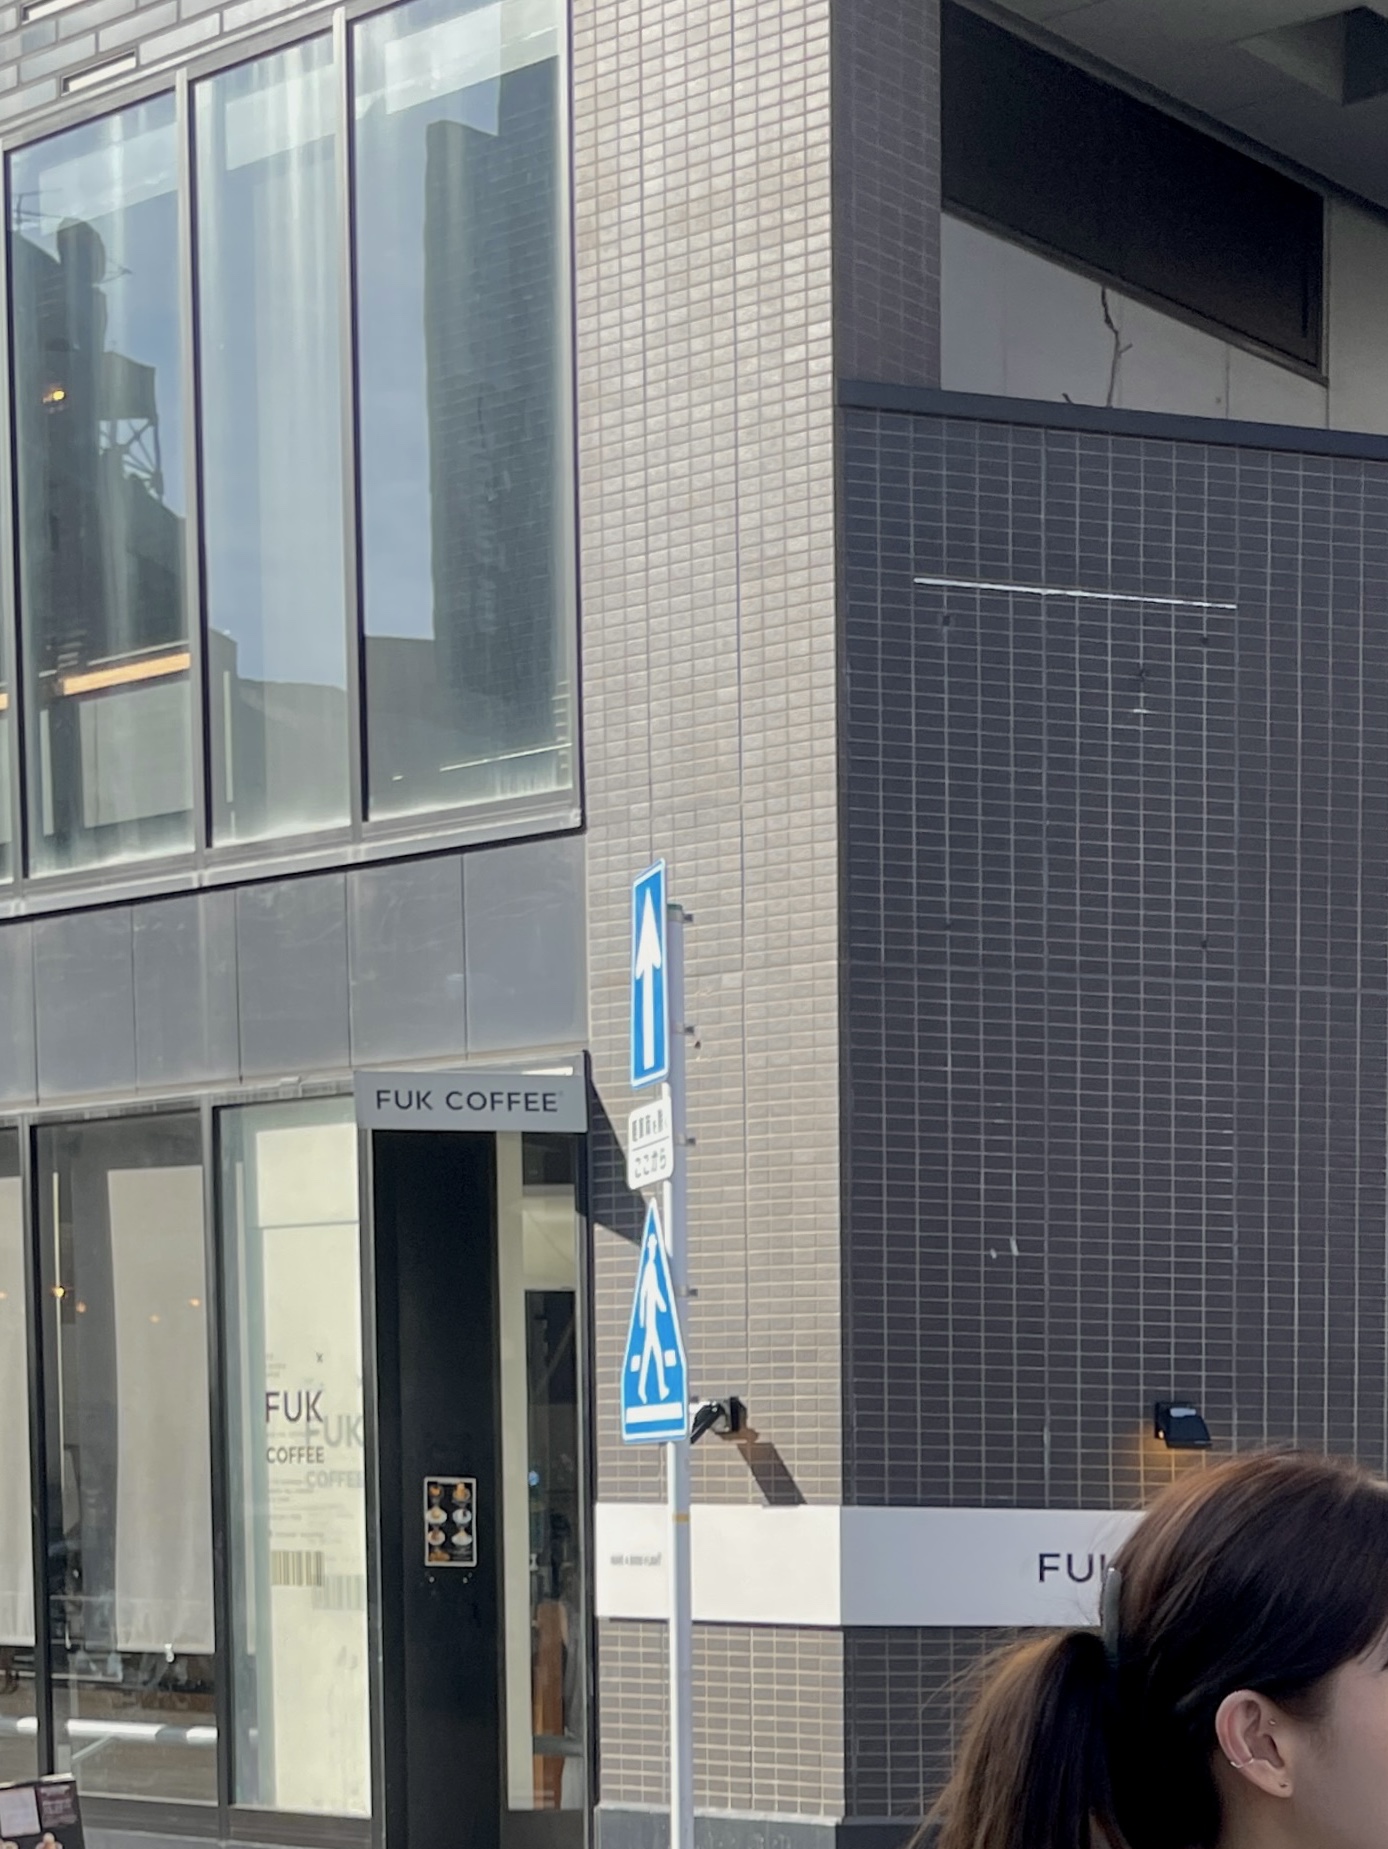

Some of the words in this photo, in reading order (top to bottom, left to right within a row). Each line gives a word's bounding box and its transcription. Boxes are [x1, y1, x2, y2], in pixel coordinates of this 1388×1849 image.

[376, 1089, 433, 1111] FUK
[445, 1090, 558, 1113] COFFEE
[634, 1147, 667, 1179] ここから
[265, 1390, 324, 1423] FUK
[266, 1446, 325, 1464] COFFEE
